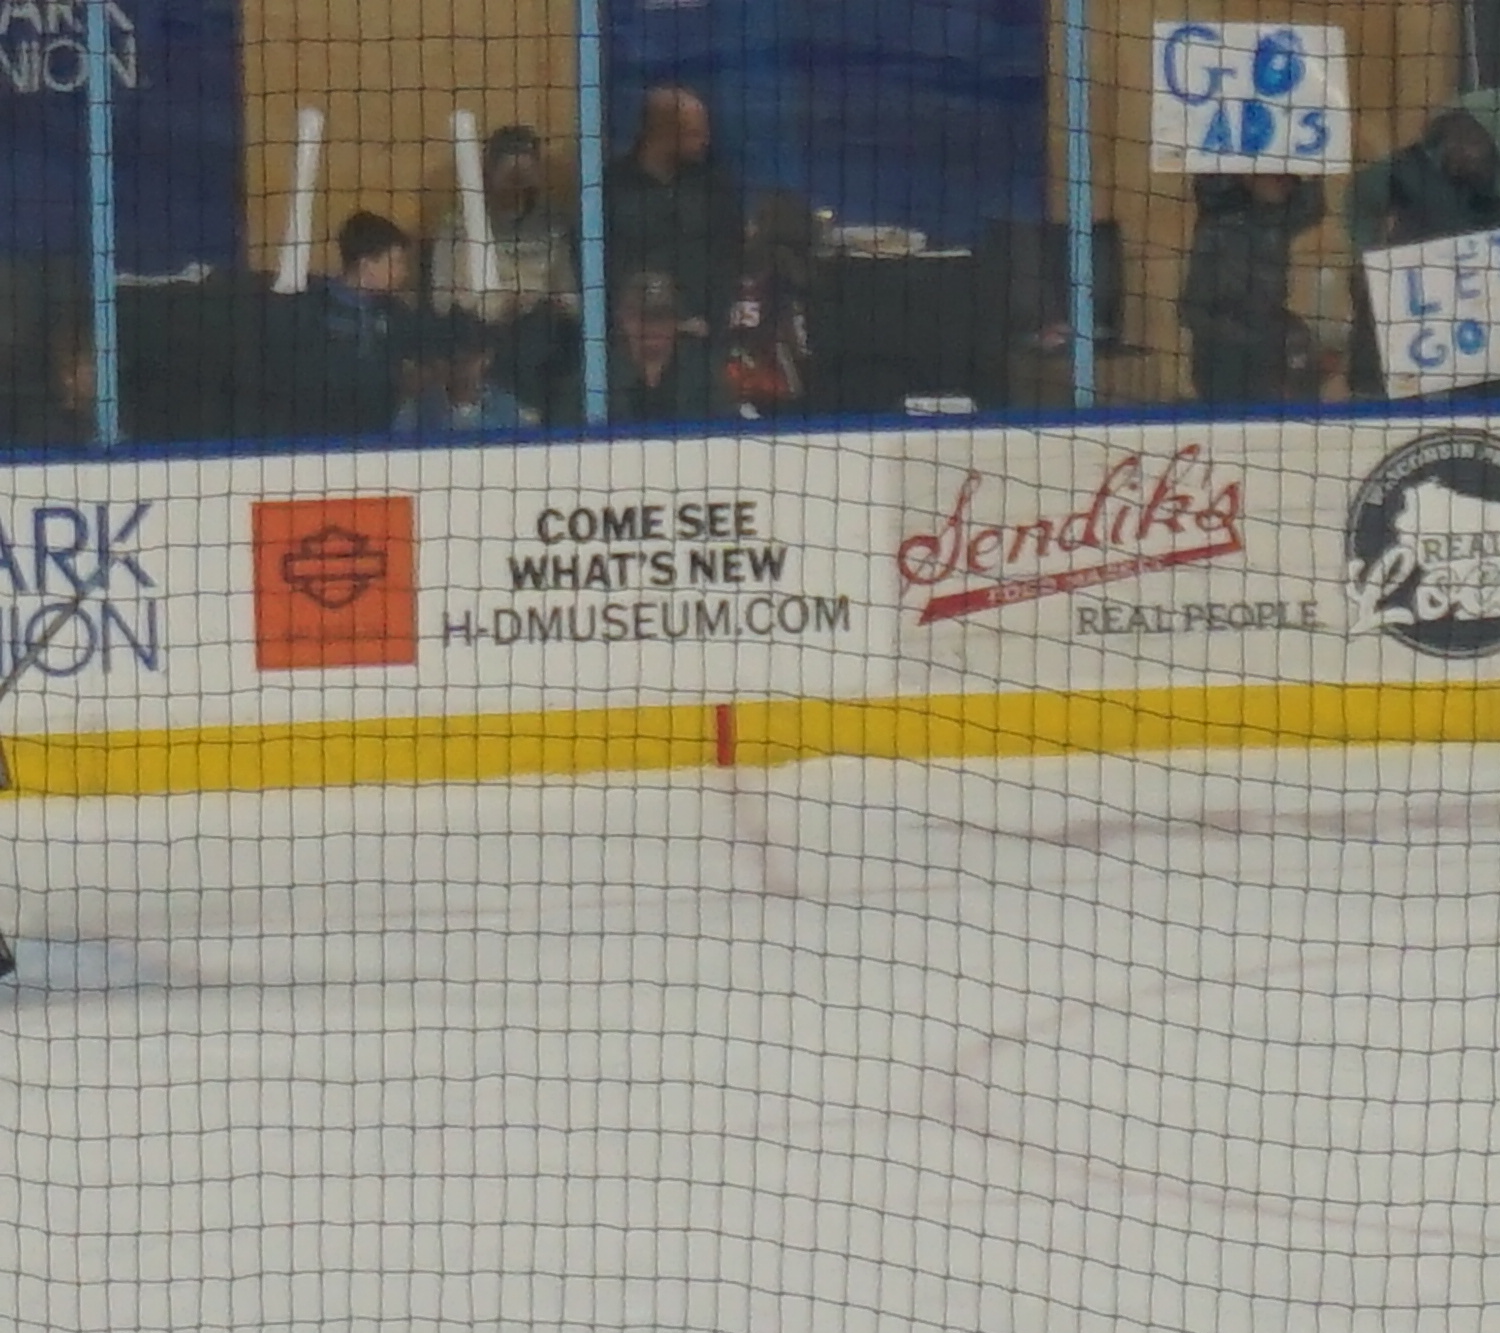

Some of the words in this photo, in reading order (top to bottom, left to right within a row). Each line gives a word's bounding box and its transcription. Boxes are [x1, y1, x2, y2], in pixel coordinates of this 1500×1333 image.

[1164, 25, 1306, 106] GO
[1202, 99, 1331, 157] ADS
[1408, 318, 1486, 367] GO
[537, 505, 666, 545] COME
[677, 501, 757, 539] SEE
[508, 550, 677, 590] WHAT'S
[689, 545, 788, 584] NEW
[0, 600, 158, 677] ION
[443, 595, 851, 648] H-DMUSEUM.COM
[1077, 603, 1173, 635] REAL
[1185, 600, 1324, 632] PEOPLE
